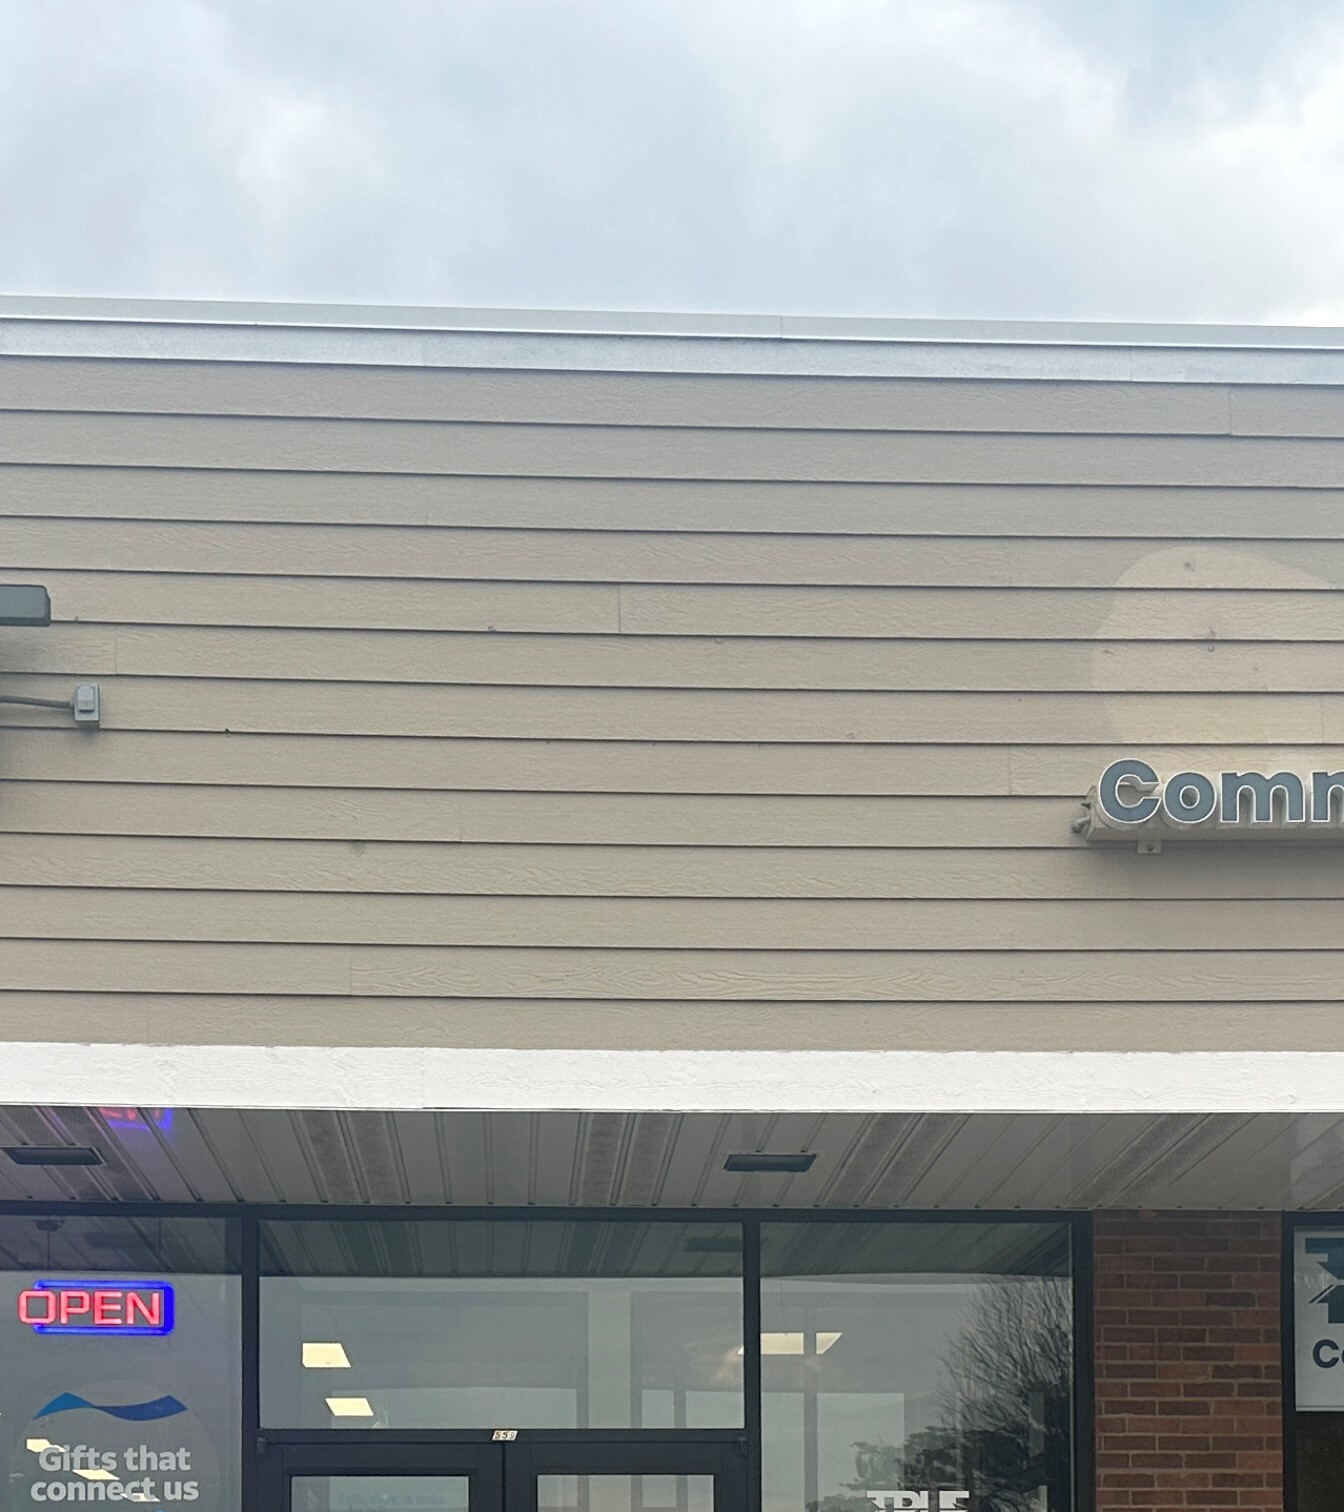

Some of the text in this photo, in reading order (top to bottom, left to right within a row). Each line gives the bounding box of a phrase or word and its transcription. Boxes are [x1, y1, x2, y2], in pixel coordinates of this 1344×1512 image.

[18, 1289, 162, 1326] OPEN
[38, 1444, 192, 1472] Gifts that
[30, 1477, 200, 1502] connect us
